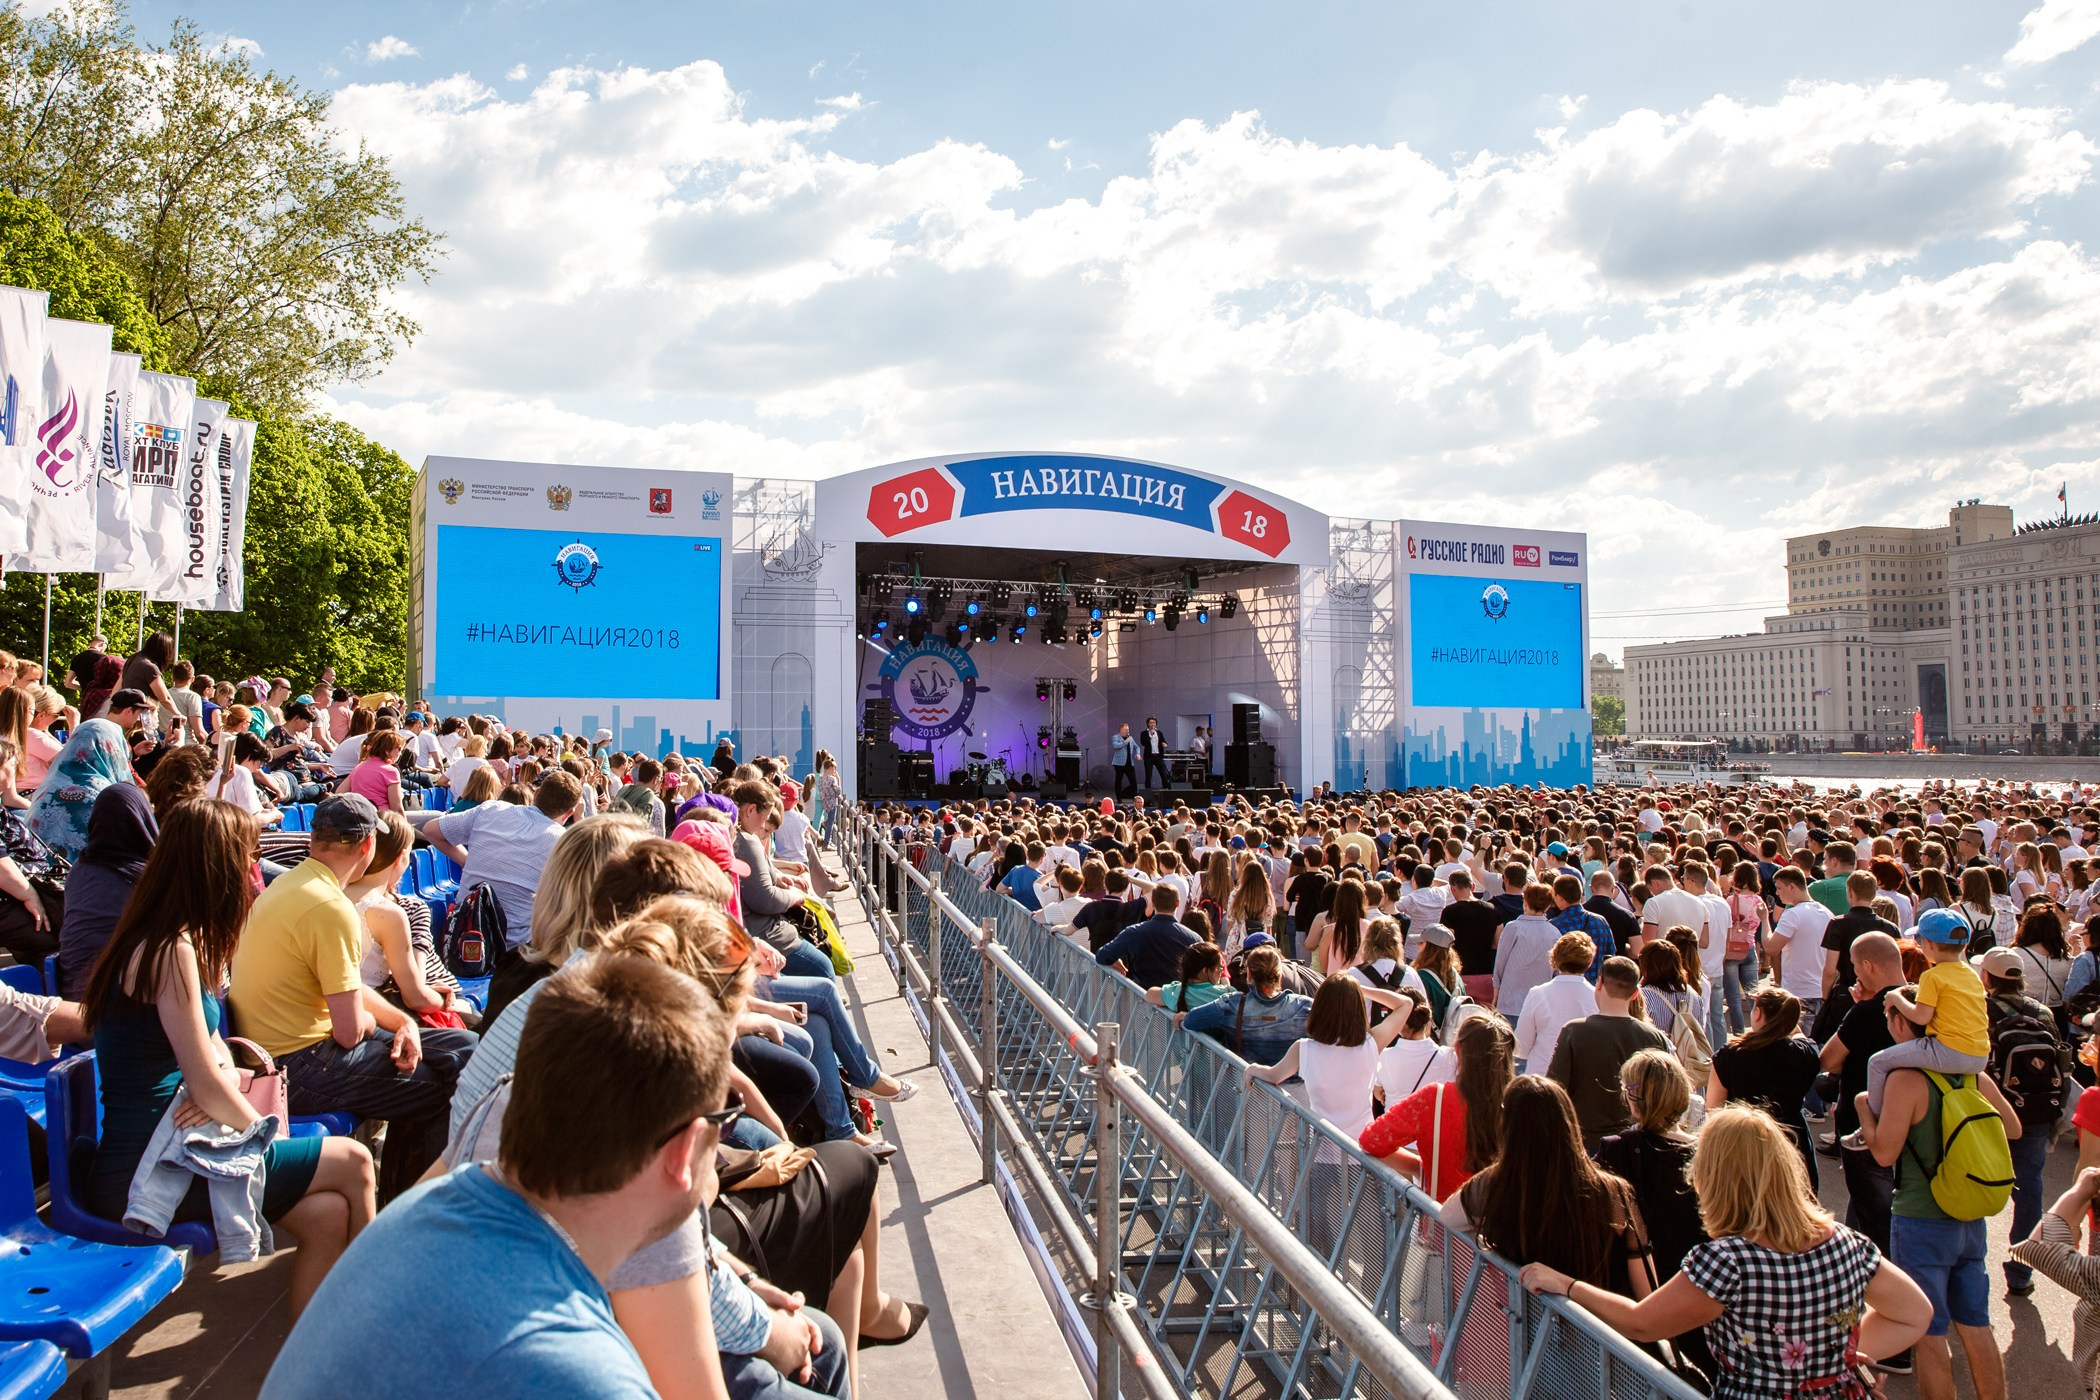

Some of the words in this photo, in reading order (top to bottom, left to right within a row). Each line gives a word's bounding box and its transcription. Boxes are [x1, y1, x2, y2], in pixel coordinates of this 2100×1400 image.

[125, 391, 134, 431] MOSCOW
[76, 434, 96, 469] ALLIANCE
[123, 435, 131, 462] ROYAL
[133, 437, 149, 446] ХТ
[152, 438, 179, 450] КЛУБ
[218, 432, 232, 470] GROUP
[73, 473, 94, 493] RIVER
[132, 473, 174, 487] АГАТИНО
[991, 468, 1187, 511] НАВИГАЦИЯ
[183, 421, 211, 578] houseboat.ru
[893, 487, 929, 519] 20
[1241, 510, 1268, 538] 18
[561, 545, 595, 560] НАВИГАЦИЯ
[1421, 539, 1467, 563] РУССКОЕ
[1472, 543, 1505, 565] РАДИО
[1515, 549, 1526, 559] RU
[466, 622, 680, 649] #НАВИГАЦИЯ2018
[889, 640, 970, 670] НАВИГАЦИЯ
[1431, 647, 1559, 666] #НАВИГАЦИЯ2018
[917, 727, 940, 737] 2018
